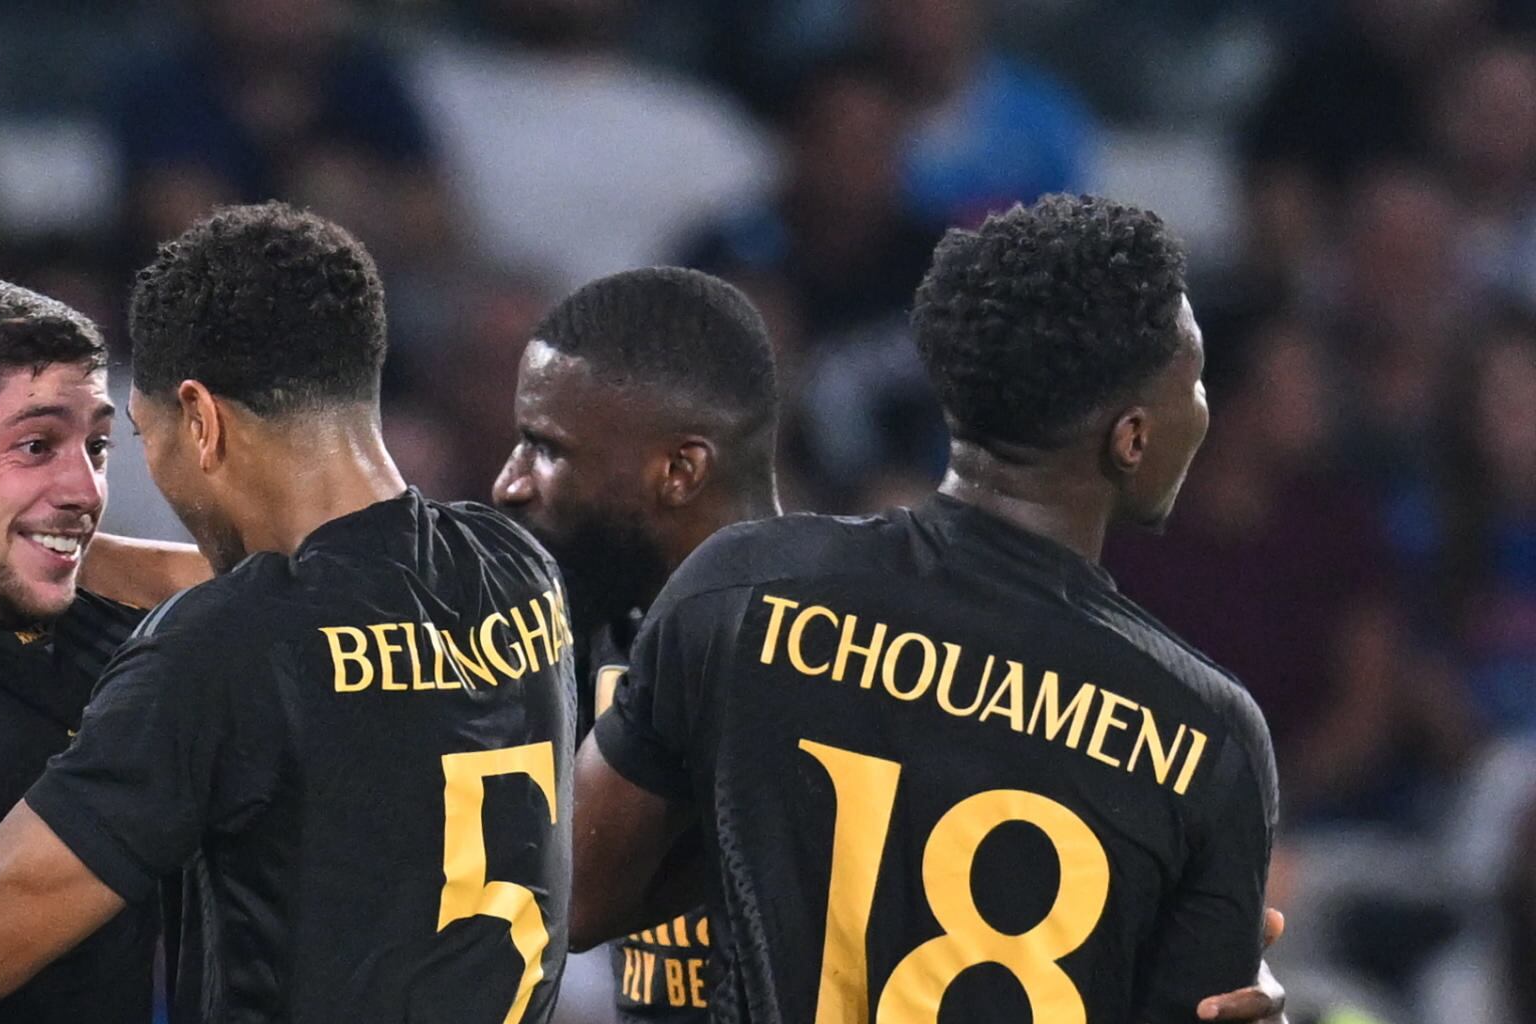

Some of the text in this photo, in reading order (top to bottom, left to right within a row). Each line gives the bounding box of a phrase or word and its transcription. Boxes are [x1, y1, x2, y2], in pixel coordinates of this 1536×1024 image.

[317, 577, 574, 693] BELLNGHA
[759, 594, 1208, 796] TCHOUAMENI
[664, 957, 710, 1009] BE
